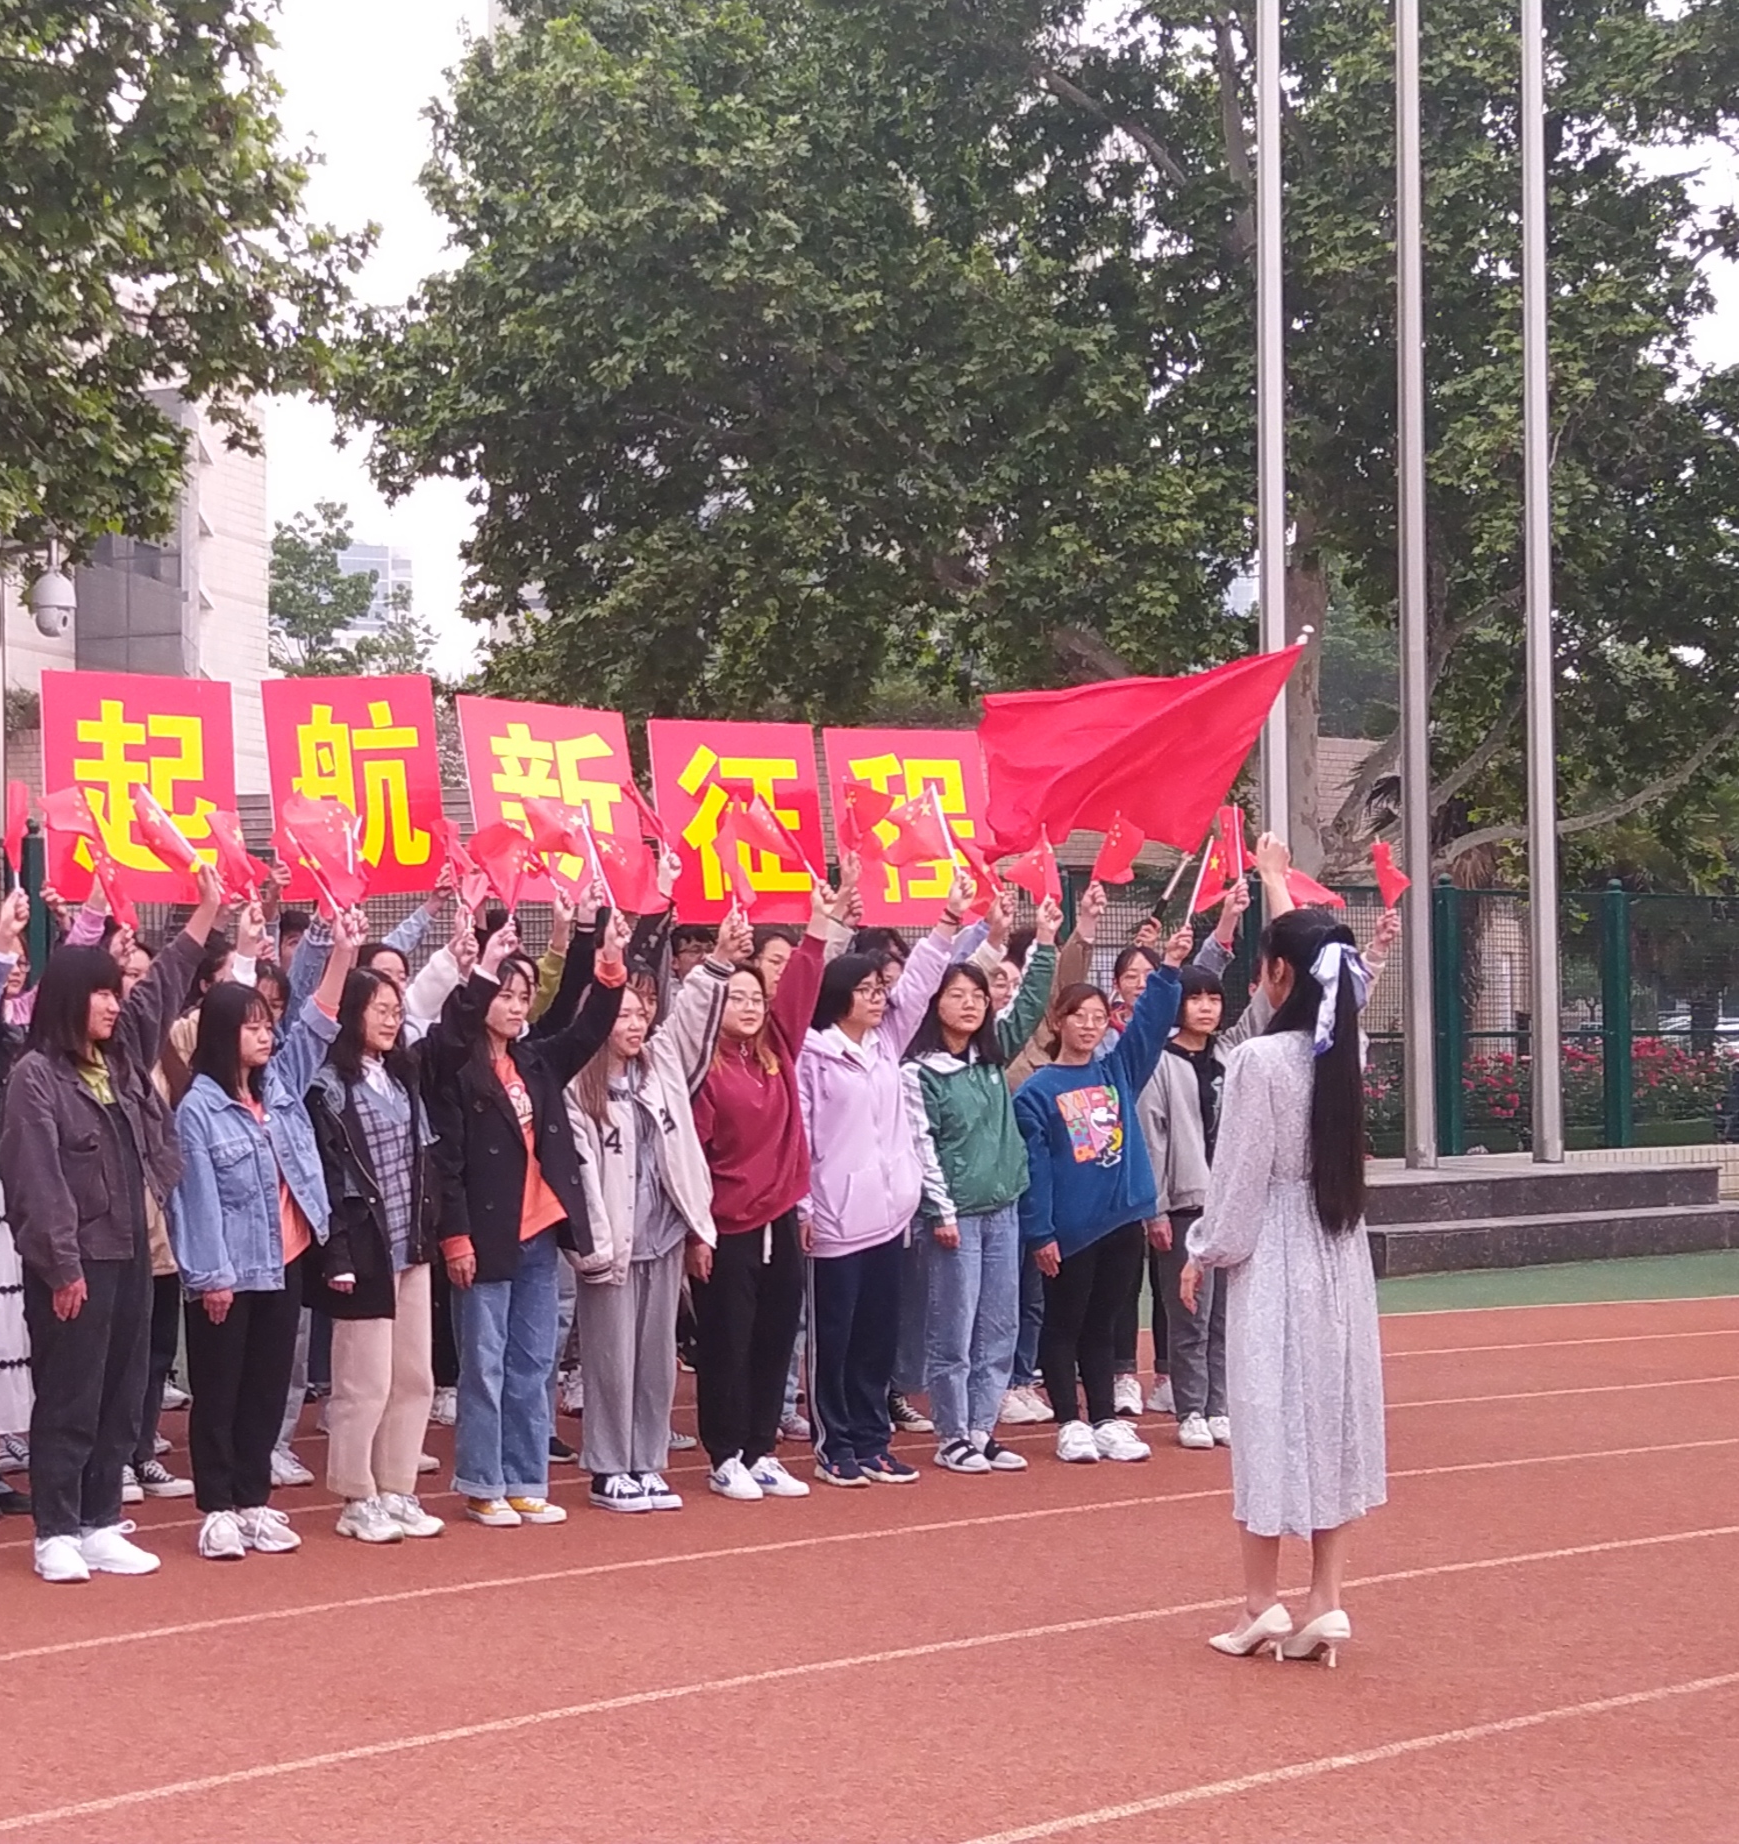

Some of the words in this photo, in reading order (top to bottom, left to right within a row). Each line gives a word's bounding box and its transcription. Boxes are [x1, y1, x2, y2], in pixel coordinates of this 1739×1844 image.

[72, 699, 218, 873] 起
[292, 700, 431, 868] 航
[490, 723, 622, 881] 新
[677, 744, 813, 900] 征
